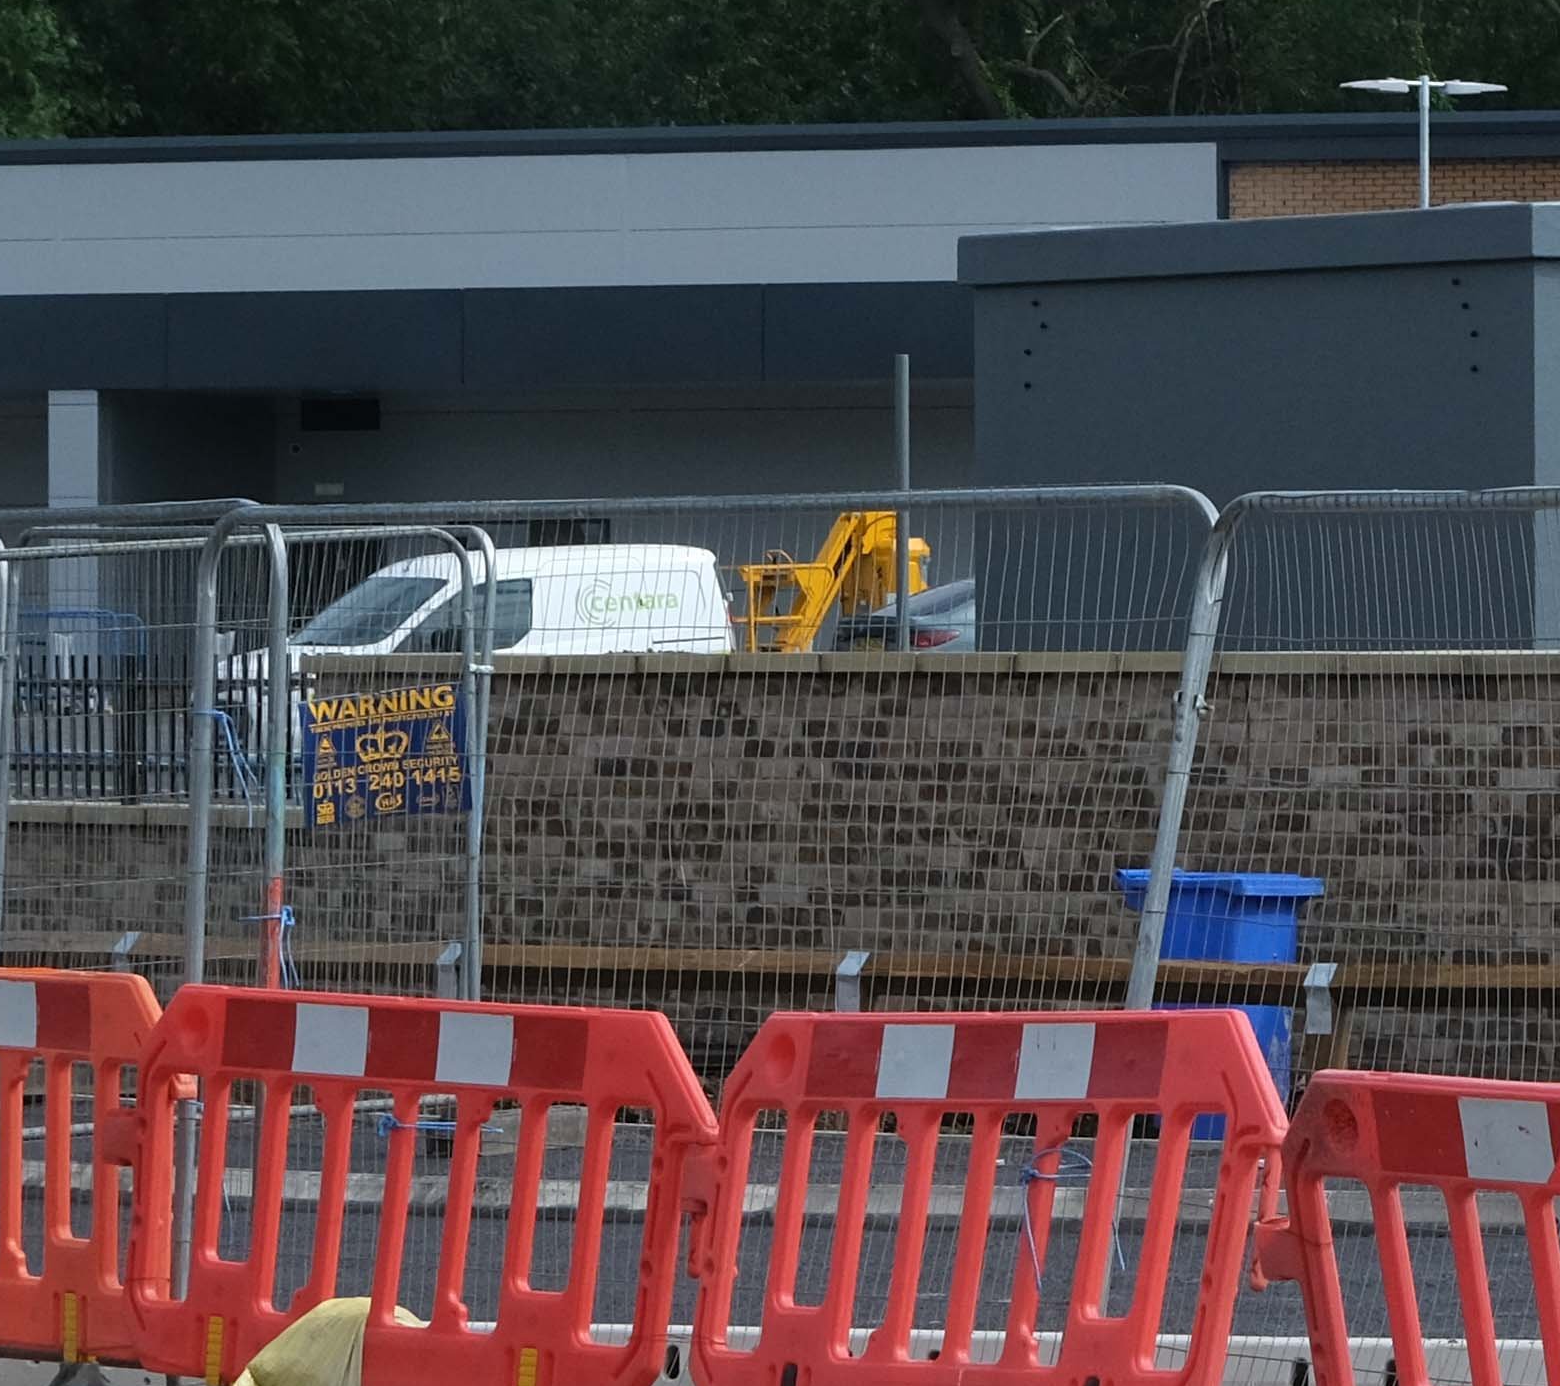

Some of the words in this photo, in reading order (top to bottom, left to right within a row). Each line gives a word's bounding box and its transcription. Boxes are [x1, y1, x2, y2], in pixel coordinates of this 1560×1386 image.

[308, 685, 456, 724] WARNING
[313, 766, 357, 783] GOLDEN
[358, 760, 400, 775] CROWN
[402, 755, 459, 770] SECURITY
[313, 777, 357, 799] 0113
[369, 771, 405, 791] 240
[412, 766, 461, 786] 1415
